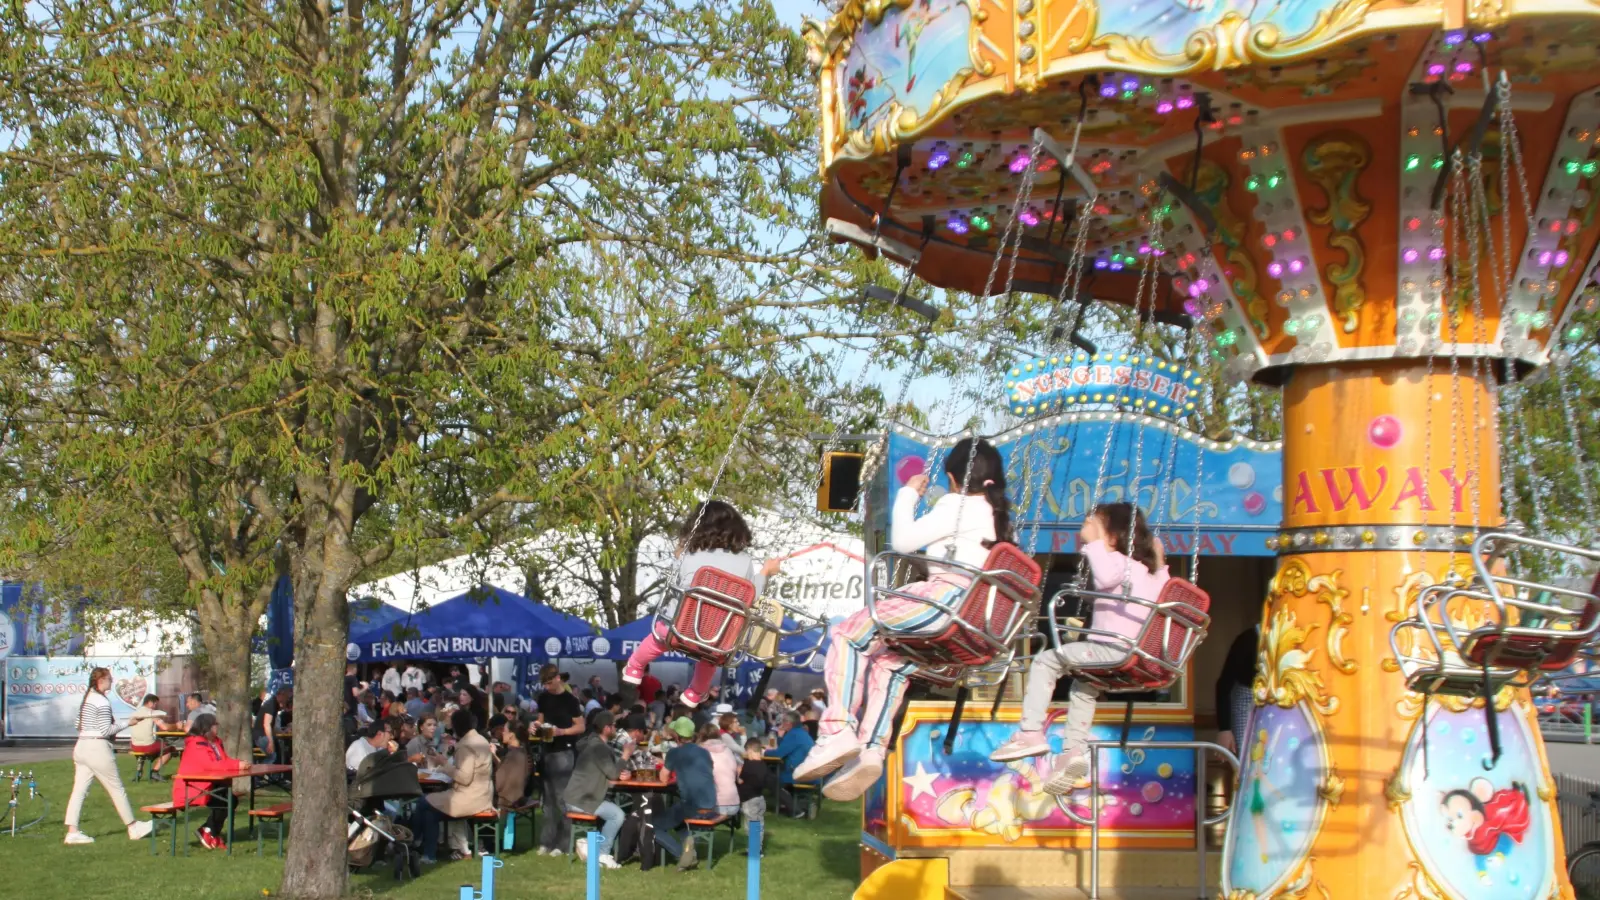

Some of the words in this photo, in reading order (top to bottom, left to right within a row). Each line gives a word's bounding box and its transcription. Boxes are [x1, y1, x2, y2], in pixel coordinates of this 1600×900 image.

[1015, 364, 1190, 404] NUNGESSER
[1291, 465, 1476, 516] AWAY
[1163, 532, 1238, 555] WAY
[371, 637, 449, 658] FRANKEN
[452, 636, 532, 654] BRUNNEN
